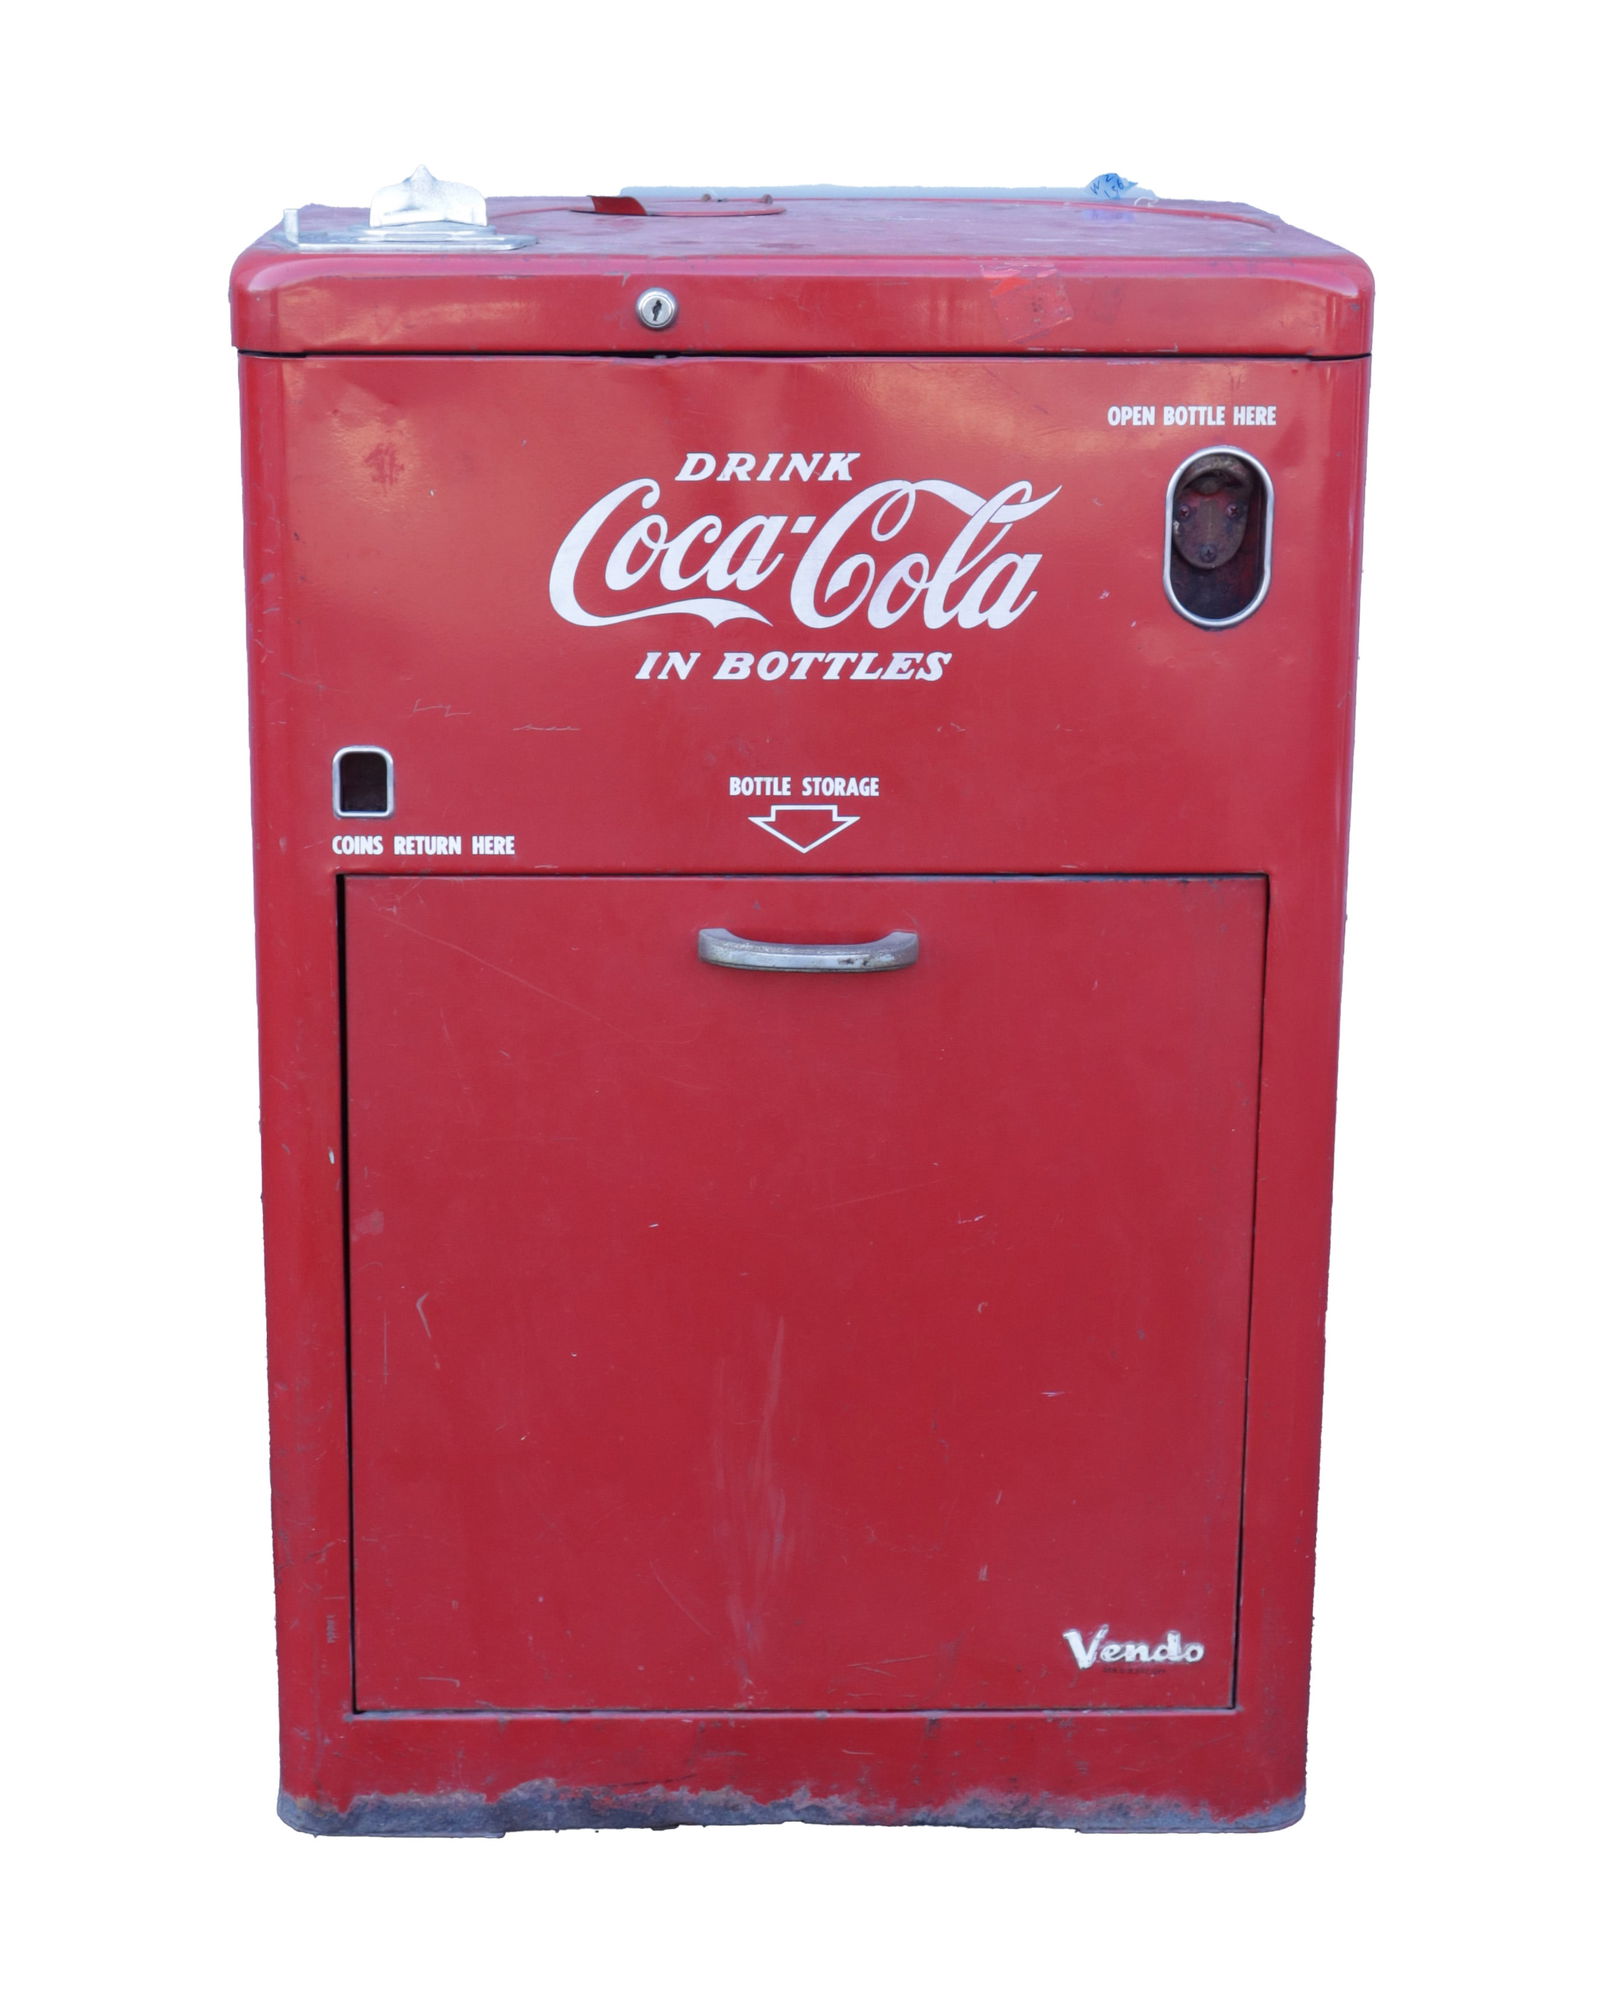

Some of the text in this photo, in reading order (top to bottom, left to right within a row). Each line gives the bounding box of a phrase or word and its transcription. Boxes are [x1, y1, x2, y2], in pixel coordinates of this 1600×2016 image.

[1107, 405, 1277, 427] OPEN BOTTLE HERE
[675, 452, 860, 482] DRINK
[549, 477, 1062, 630] Coca-Cola
[635, 651, 953, 682] IN BOTTLES
[729, 776, 880, 797] BOTTLE STORAGE
[332, 835, 516, 856] COINS RETURN HERE
[1062, 1624, 1205, 1669] Vendo
